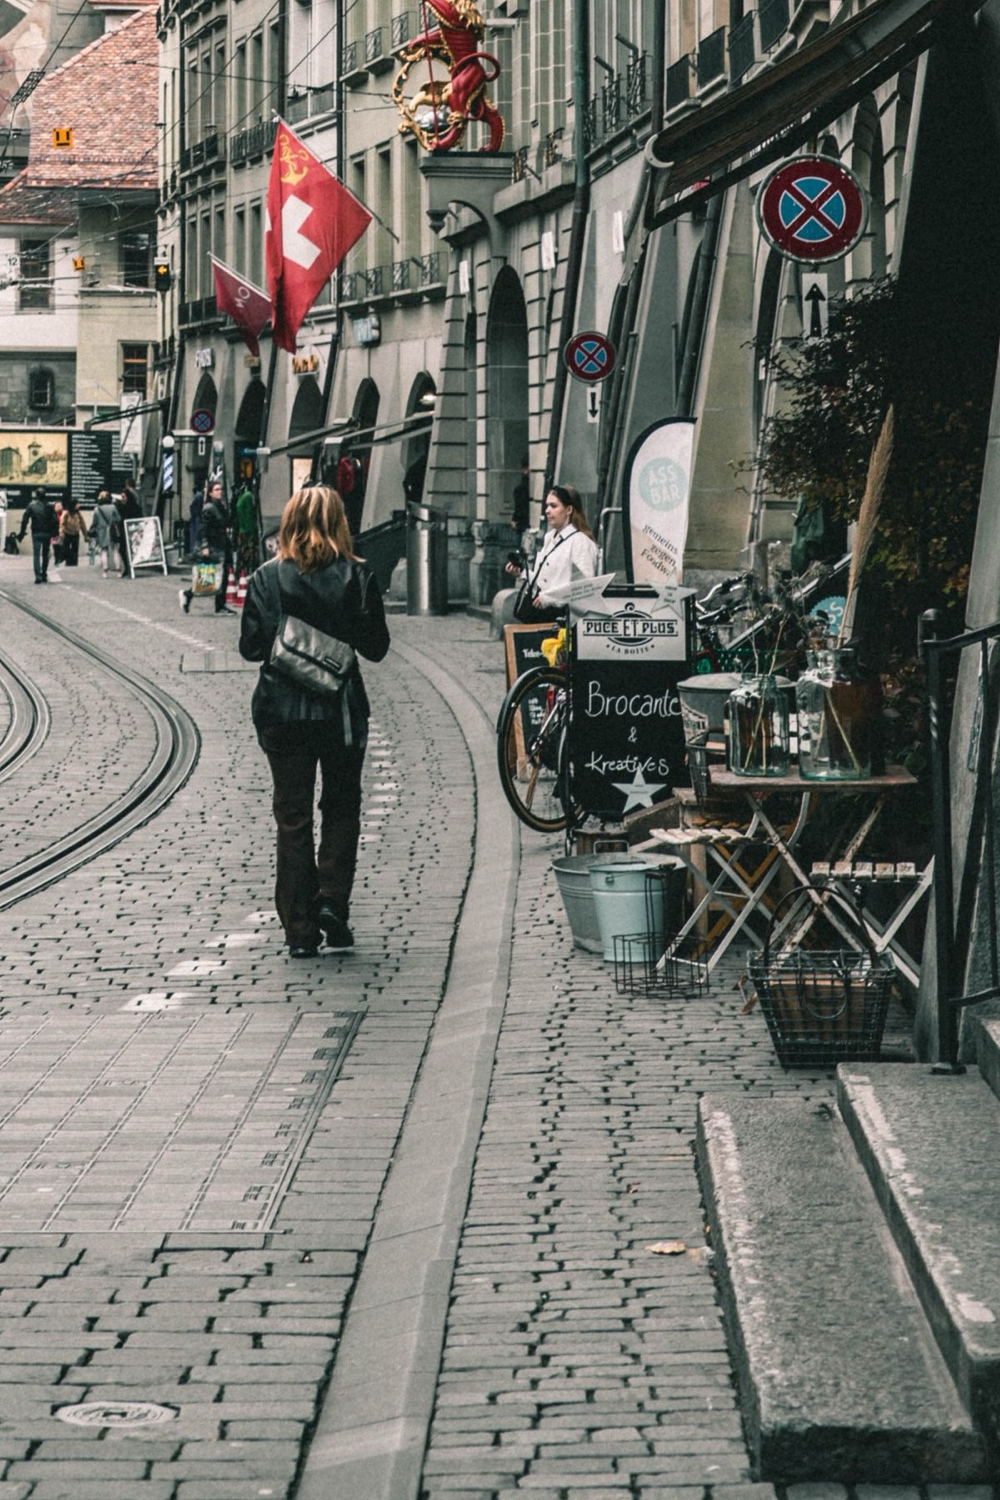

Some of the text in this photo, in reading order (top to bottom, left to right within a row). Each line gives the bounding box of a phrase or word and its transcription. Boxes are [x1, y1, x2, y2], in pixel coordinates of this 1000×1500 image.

[648, 464, 677, 486] ASS
[651, 484, 680, 505] BAR
[586, 620, 675, 636] PUCE ET PLUS
[585, 680, 682, 717] Brocante
[628, 726, 637, 742] &
[585, 751, 669, 776] Kreatives
